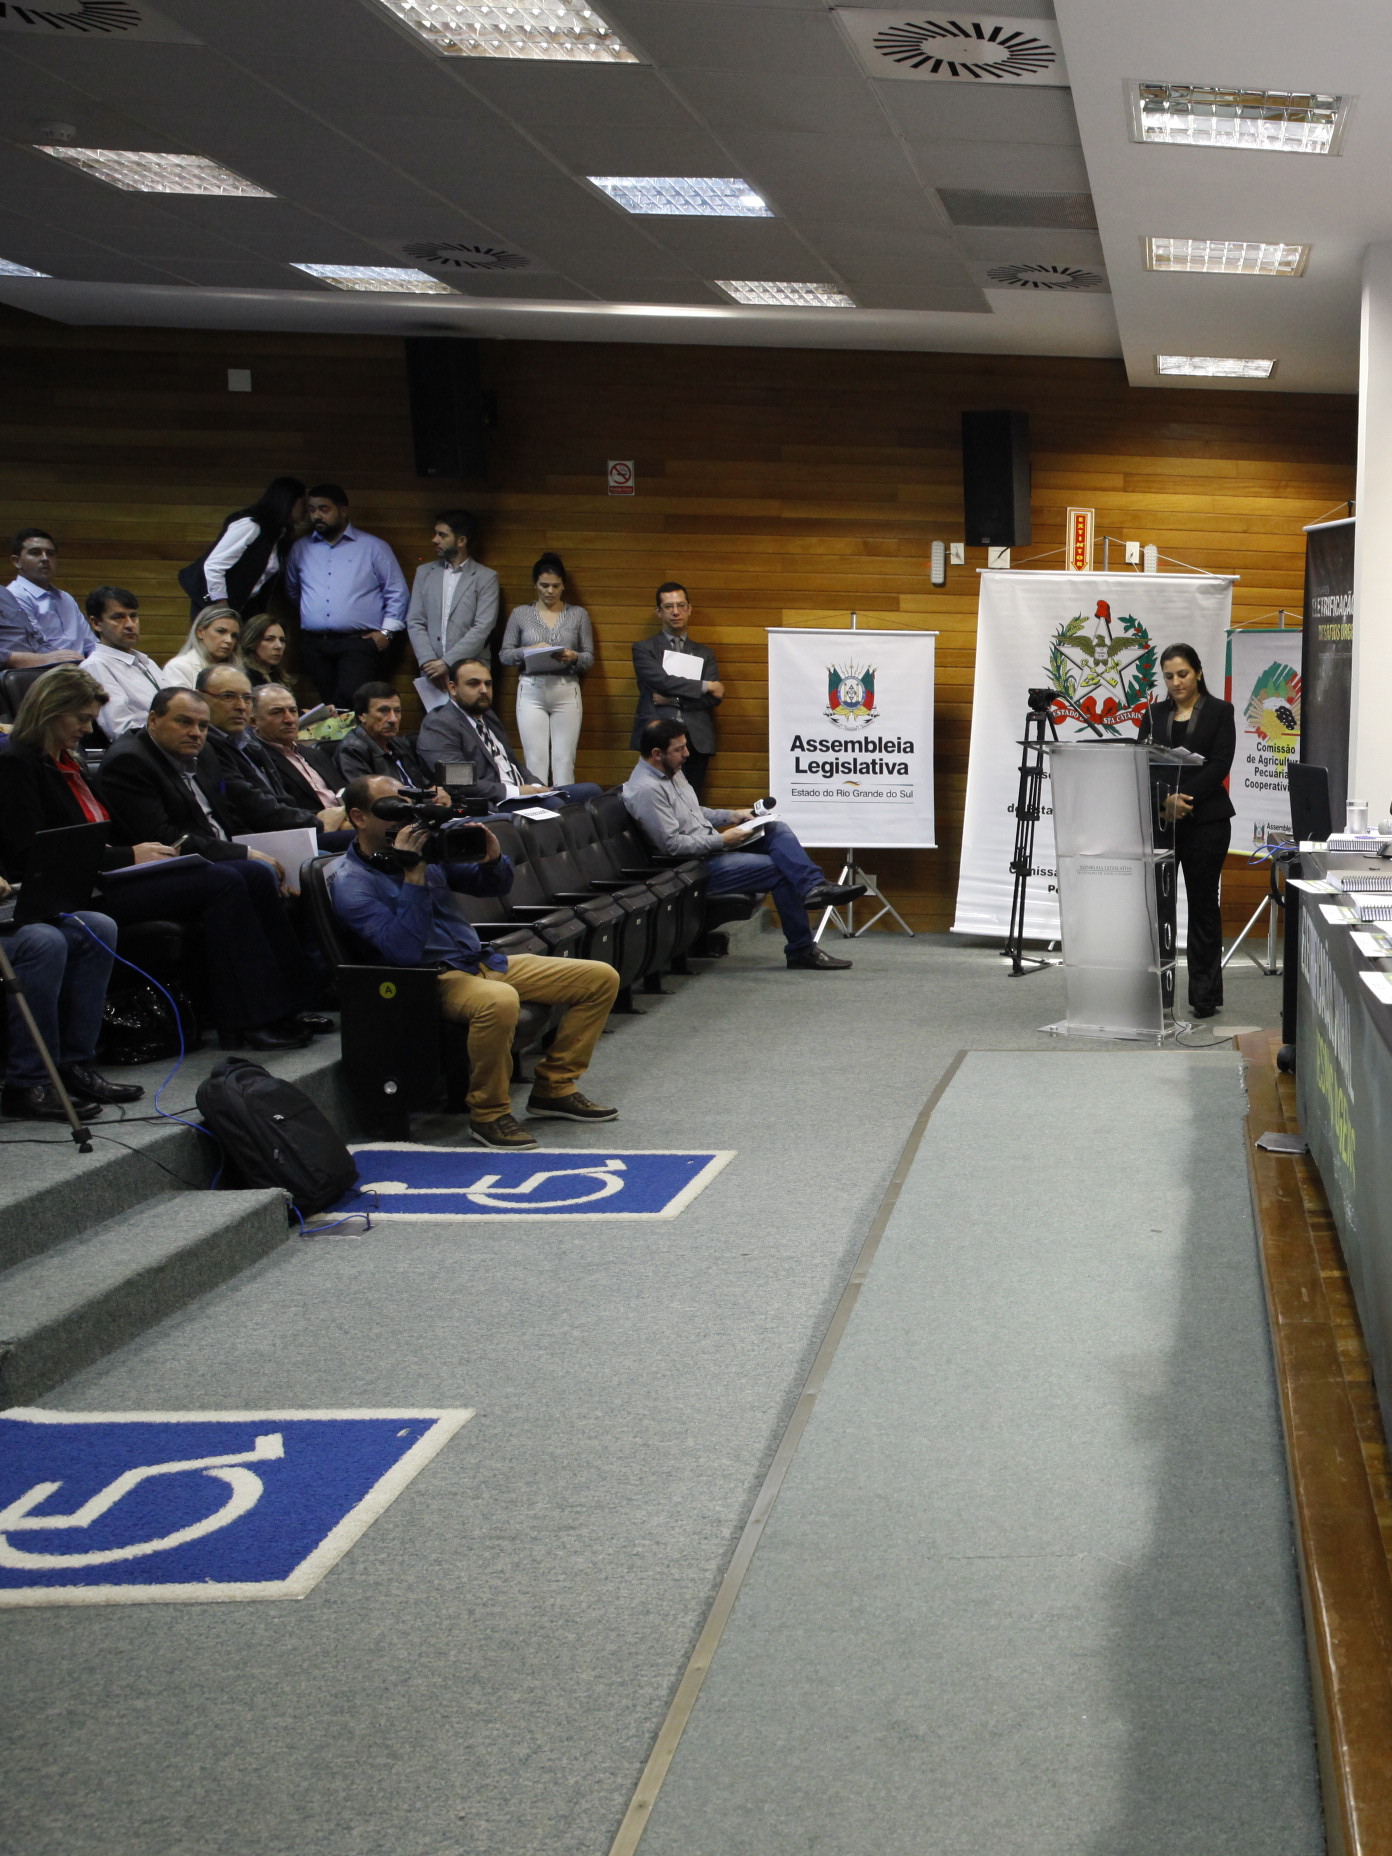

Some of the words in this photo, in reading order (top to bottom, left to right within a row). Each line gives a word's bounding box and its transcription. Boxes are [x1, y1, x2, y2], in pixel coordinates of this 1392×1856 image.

[1076, 517, 1084, 567] EXTINTOR
[790, 734, 915, 754] Assembleia
[1256, 742, 1296, 755] Comissão
[1246, 754, 1256, 764] de
[794, 756, 909, 779] Legislativa
[791, 788, 821, 798] Estado
[822, 788, 834, 798] do
[836, 788, 850, 798] Rio
[852, 789, 884, 799] Grande
[886, 789, 898, 799] do
[900, 789, 914, 799] Sul
[1266, 822, 1292, 833] Assemble
[384, 986, 393, 995] A
